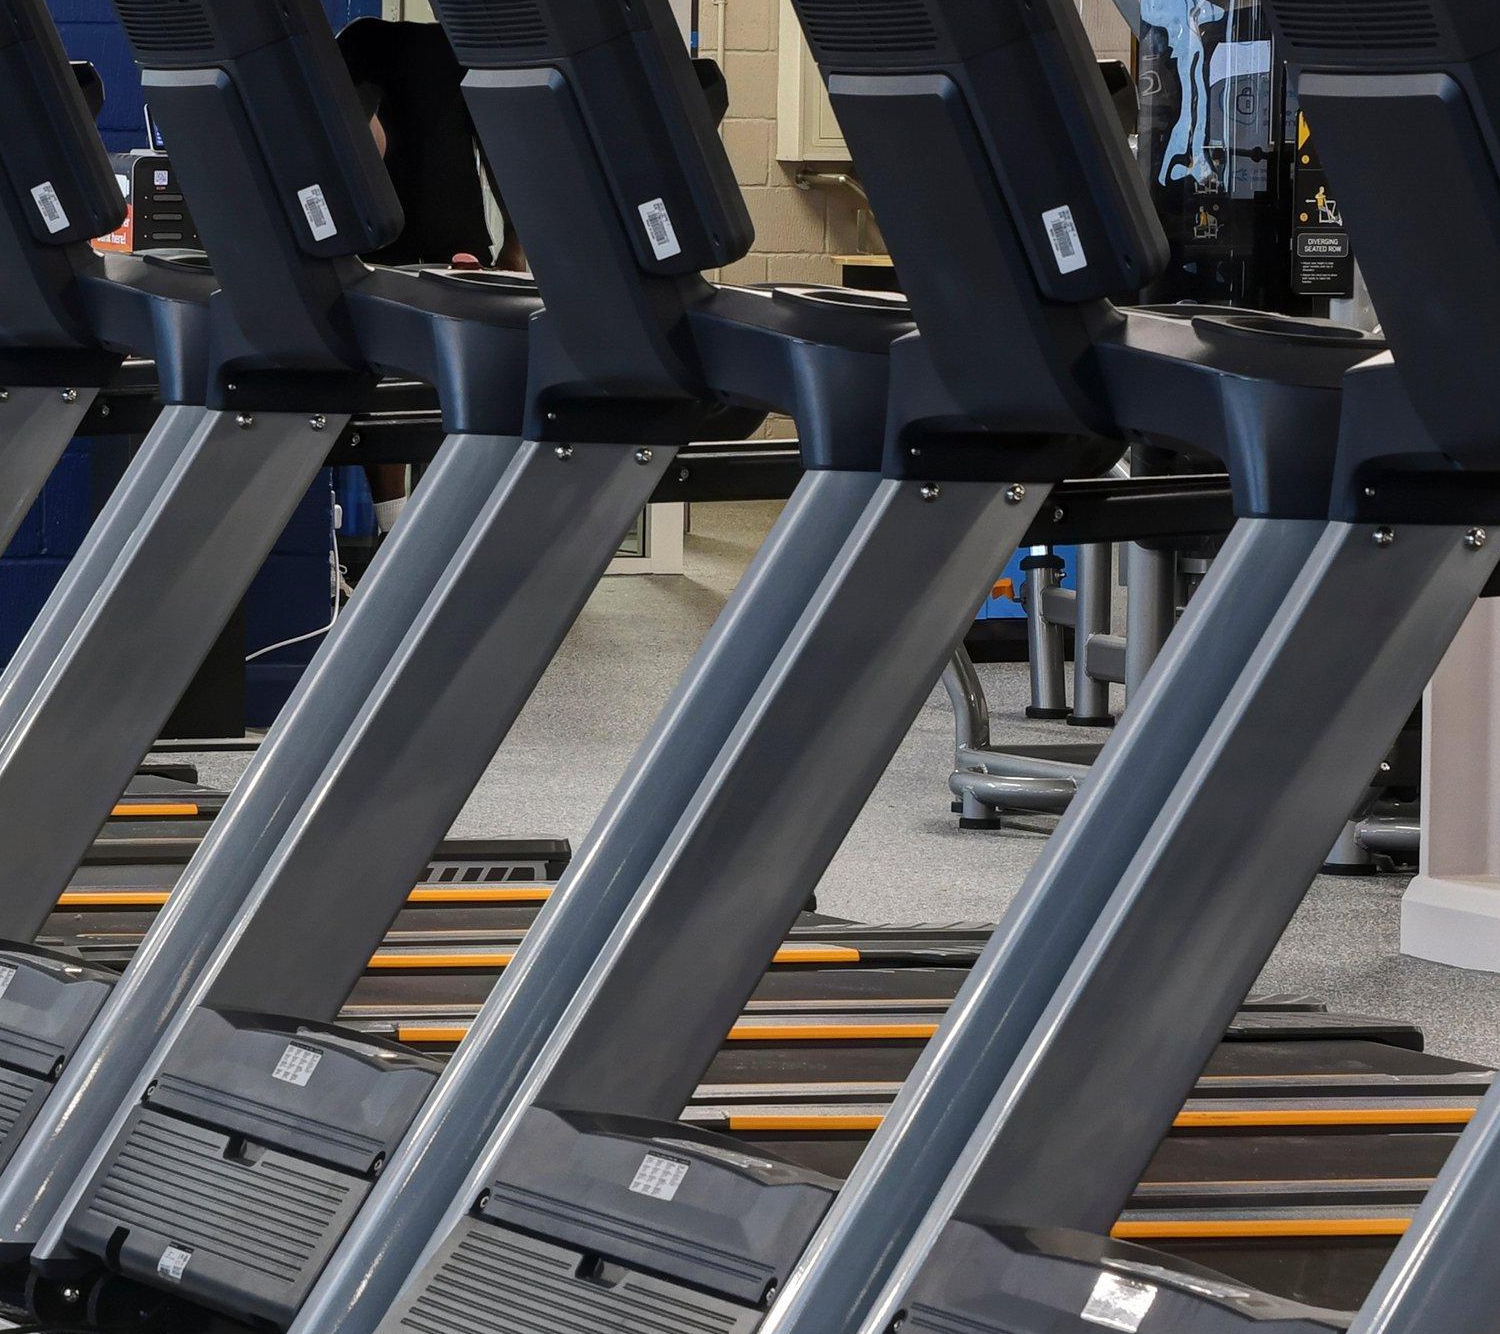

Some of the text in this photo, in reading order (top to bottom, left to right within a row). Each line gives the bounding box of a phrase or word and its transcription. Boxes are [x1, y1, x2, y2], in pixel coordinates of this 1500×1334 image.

[1307, 238, 1339, 246] DIVERGING
[1304, 245, 1342, 253] SEATED ROW
